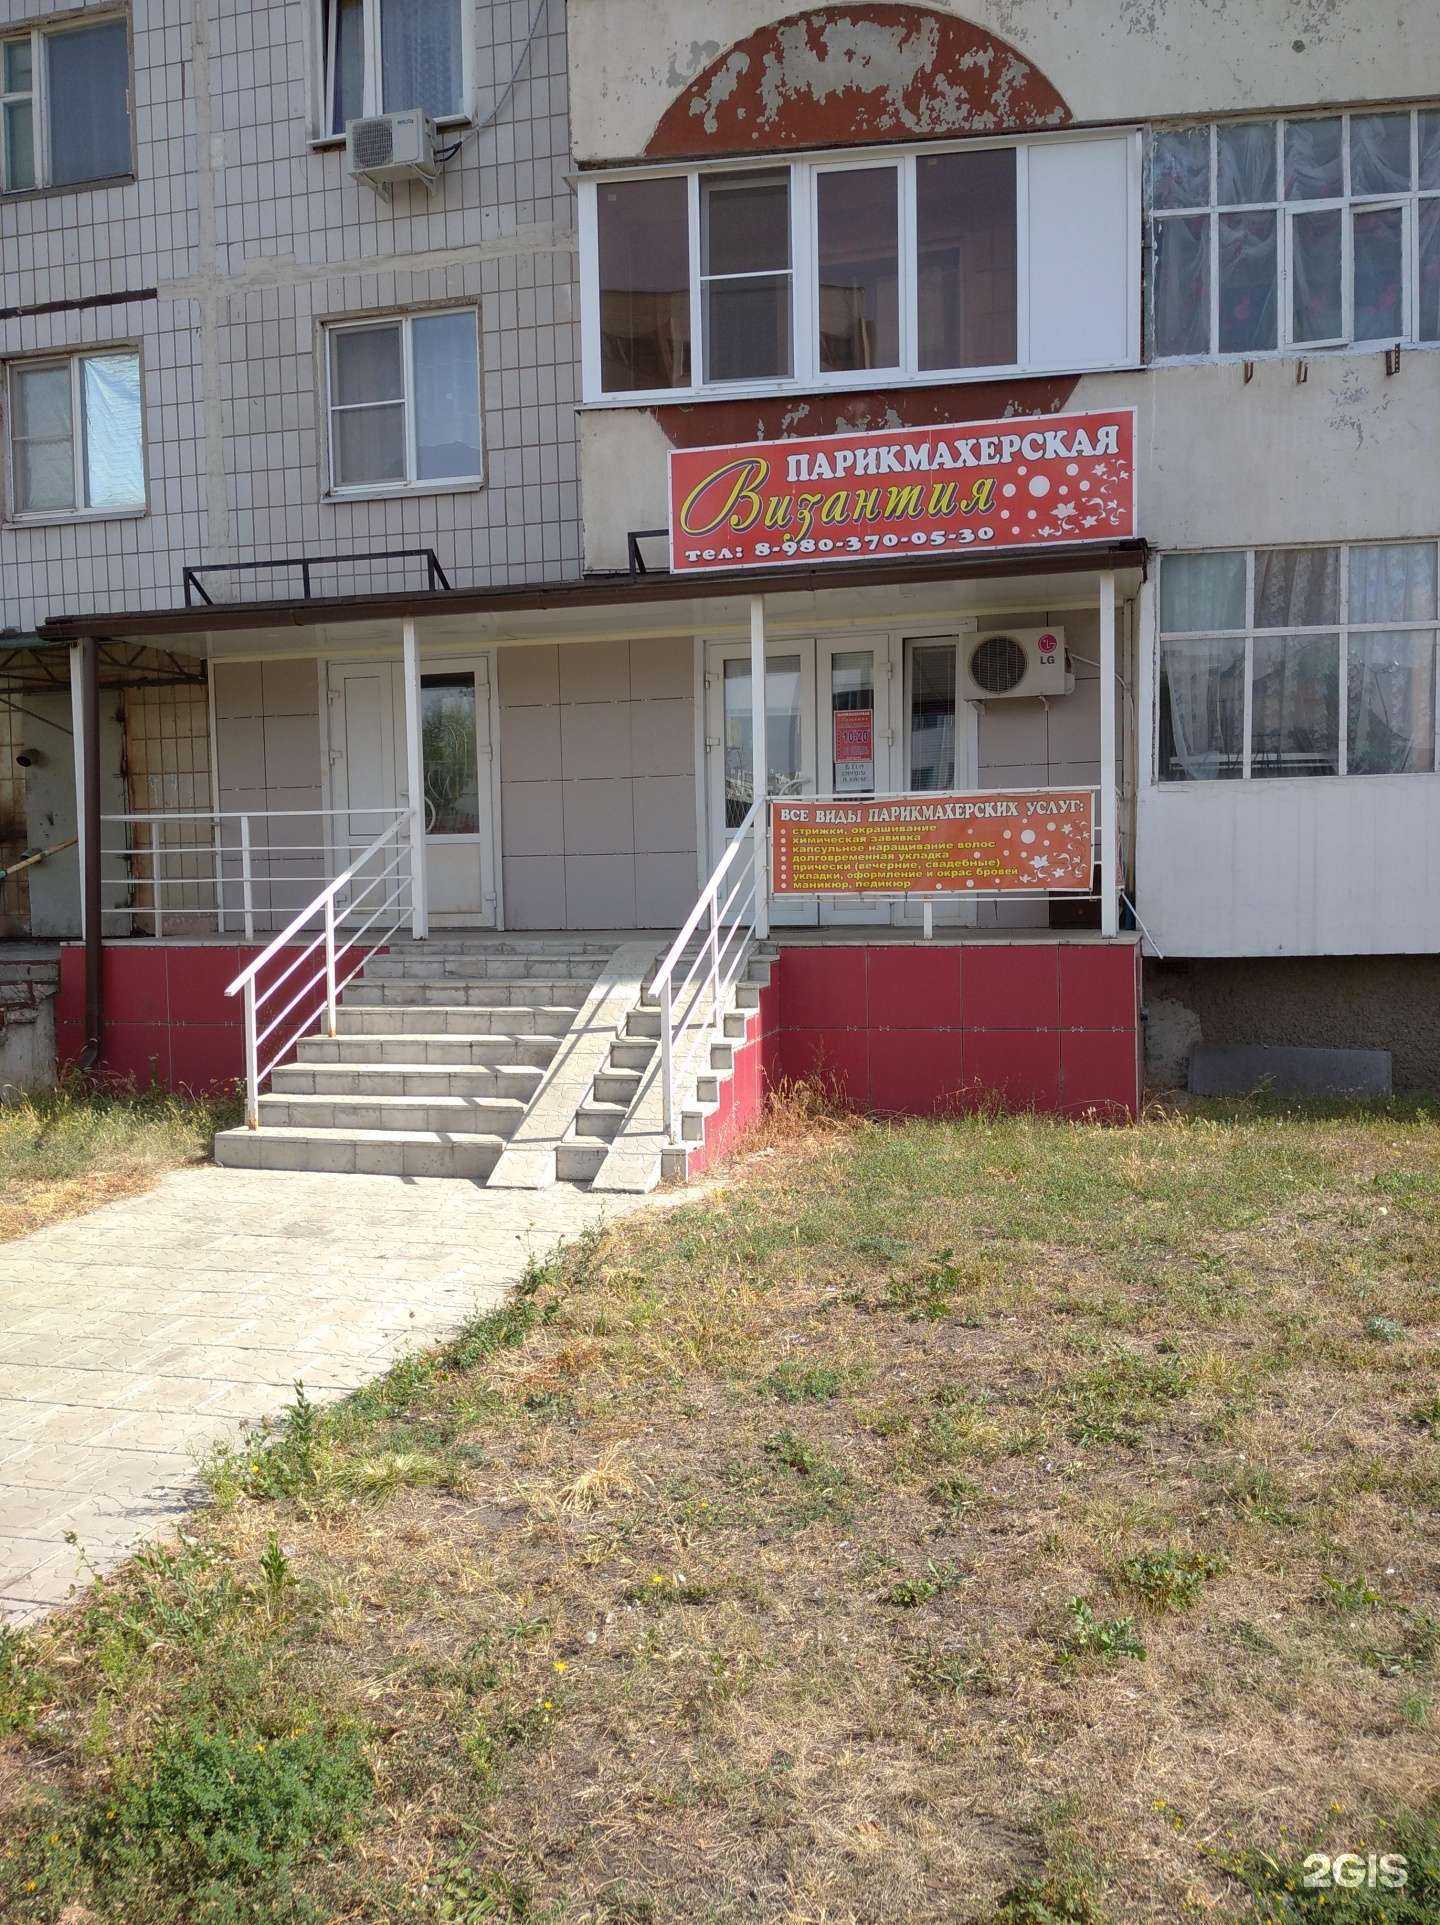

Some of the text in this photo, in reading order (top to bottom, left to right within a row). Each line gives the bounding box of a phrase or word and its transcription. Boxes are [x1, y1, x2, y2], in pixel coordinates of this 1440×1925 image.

[787, 425, 1120, 483] ПАРИКМАХЕРСКАЯ
[680, 457, 998, 542] Византия
[685, 526, 995, 562] тел: 8-980-370-05-30
[1040, 655, 1055, 665] LG
[780, 799, 1085, 824] ВСЕ ВИДЫ ПАРИКМАХЕРСКИХ УСЛУГ:
[792, 825, 937, 836] стрижки, окрашивание
[792, 834, 921, 844] химическая завивка
[792, 841, 996, 854] капсульное наращивание волос
[792, 851, 950, 863] долговременная укладка
[793, 858, 1001, 872] прически (вечерние, свадебные)
[847, 871, 923, 880] оформление
[936, 870, 973, 878] окрас
[975, 866, 1019, 877] бровей
[855, 880, 912, 889] педикюр
